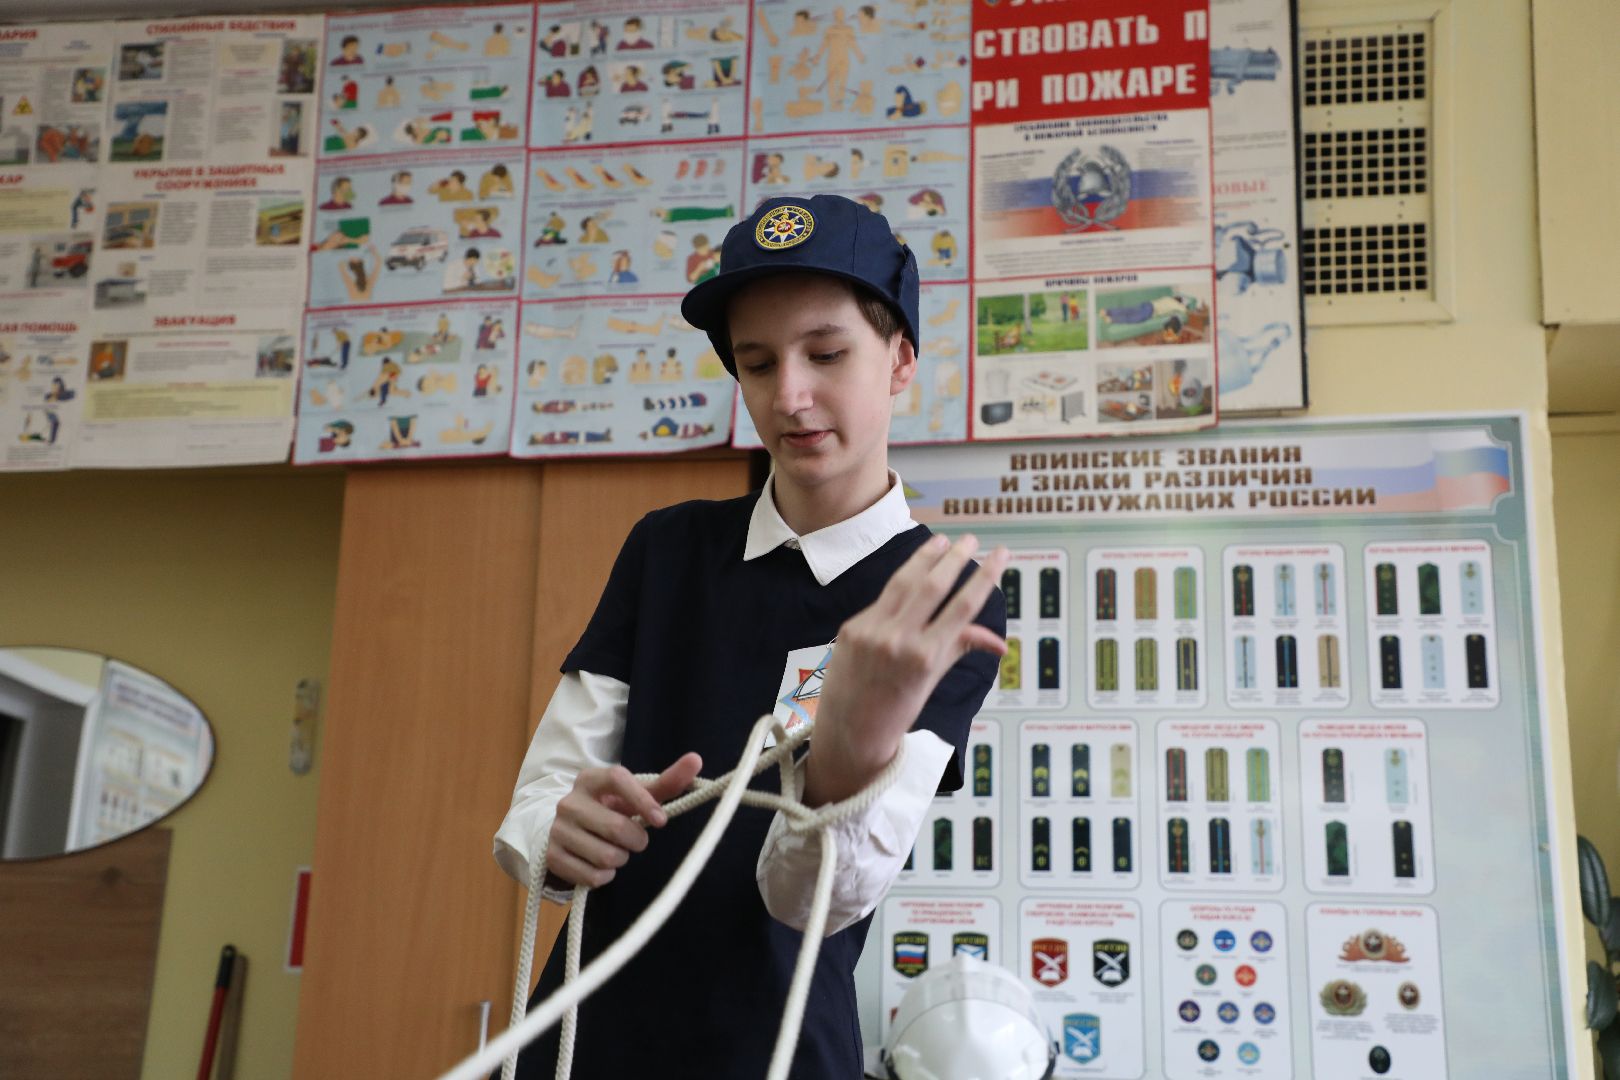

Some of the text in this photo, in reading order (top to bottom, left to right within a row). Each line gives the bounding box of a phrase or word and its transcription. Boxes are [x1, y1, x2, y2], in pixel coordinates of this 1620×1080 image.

[974, 10, 1206, 58] СТВОВАТЬ П
[972, 64, 1197, 111] РИ ПОЖАРЕ
[1010, 446, 1302, 471] ВОИНСКИЕ ЗВАНИЯ
[1001, 467, 1312, 492] И ЗНАКИ РАЗЛИЧИЯ
[943, 488, 1376, 515] ВОЕННОСЛУЖАЩИХ РОССИИ
